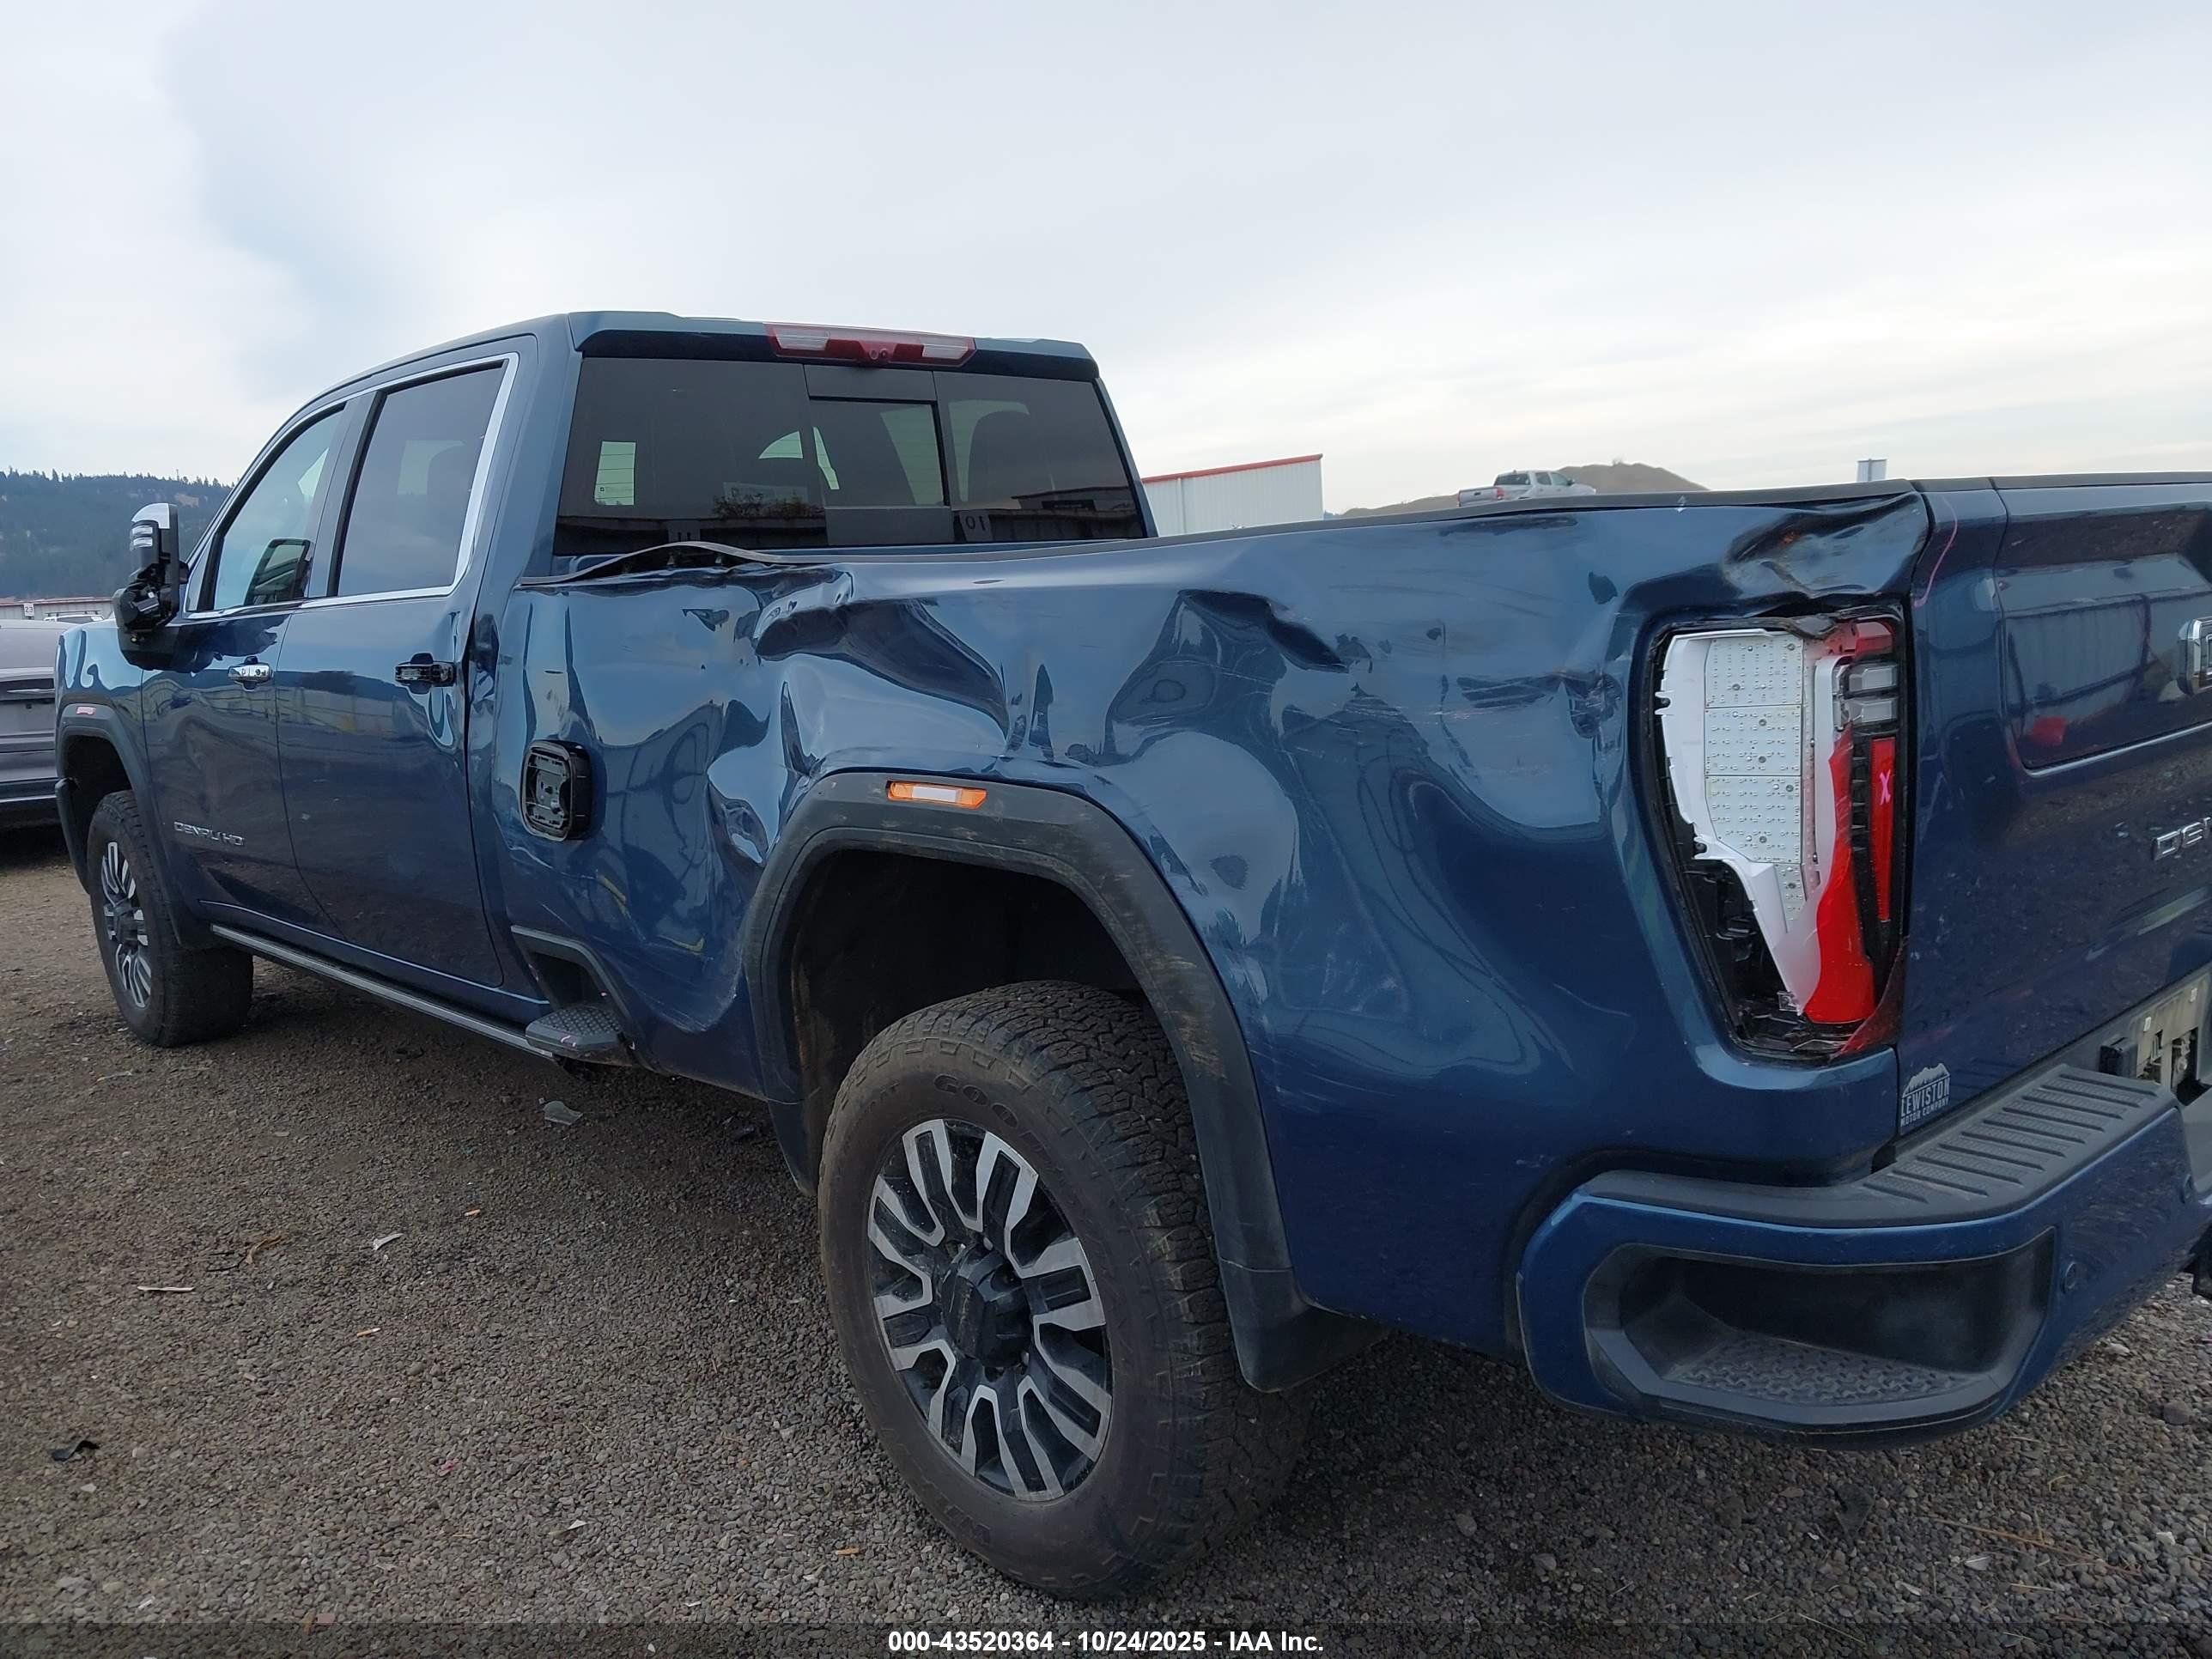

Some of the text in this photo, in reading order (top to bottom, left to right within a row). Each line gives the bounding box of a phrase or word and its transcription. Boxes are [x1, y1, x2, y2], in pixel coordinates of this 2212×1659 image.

[173, 821, 244, 846] DENALI HD
[1899, 1096, 1949, 1127] MOTOR COMPANY
[1900, 1077, 1950, 1117] LEWISTON
